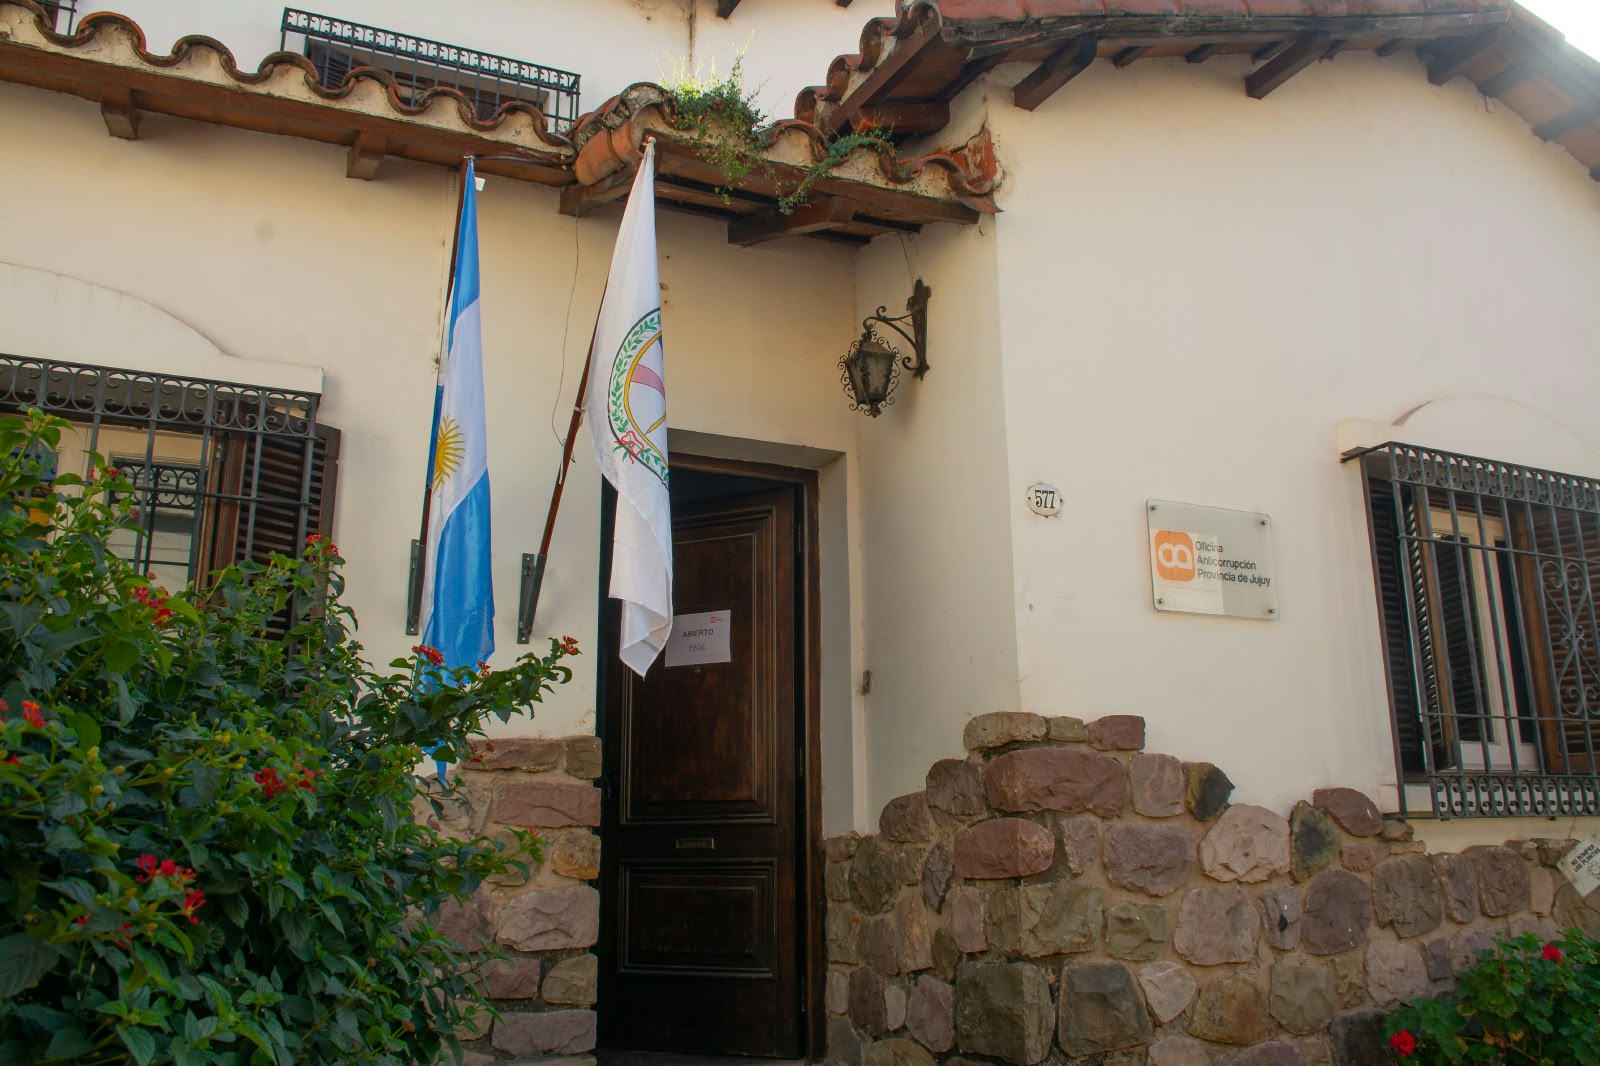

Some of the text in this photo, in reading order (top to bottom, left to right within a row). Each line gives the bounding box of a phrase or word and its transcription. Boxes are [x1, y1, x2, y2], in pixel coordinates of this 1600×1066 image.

[1034, 489, 1055, 509] 577
[1195, 541, 1224, 553] Oficina
[1197, 555, 1257, 571] Anticorrupción
[1197, 568, 1271, 587] Provincia de Jujuy
[682, 629, 714, 638] ABIERTO
